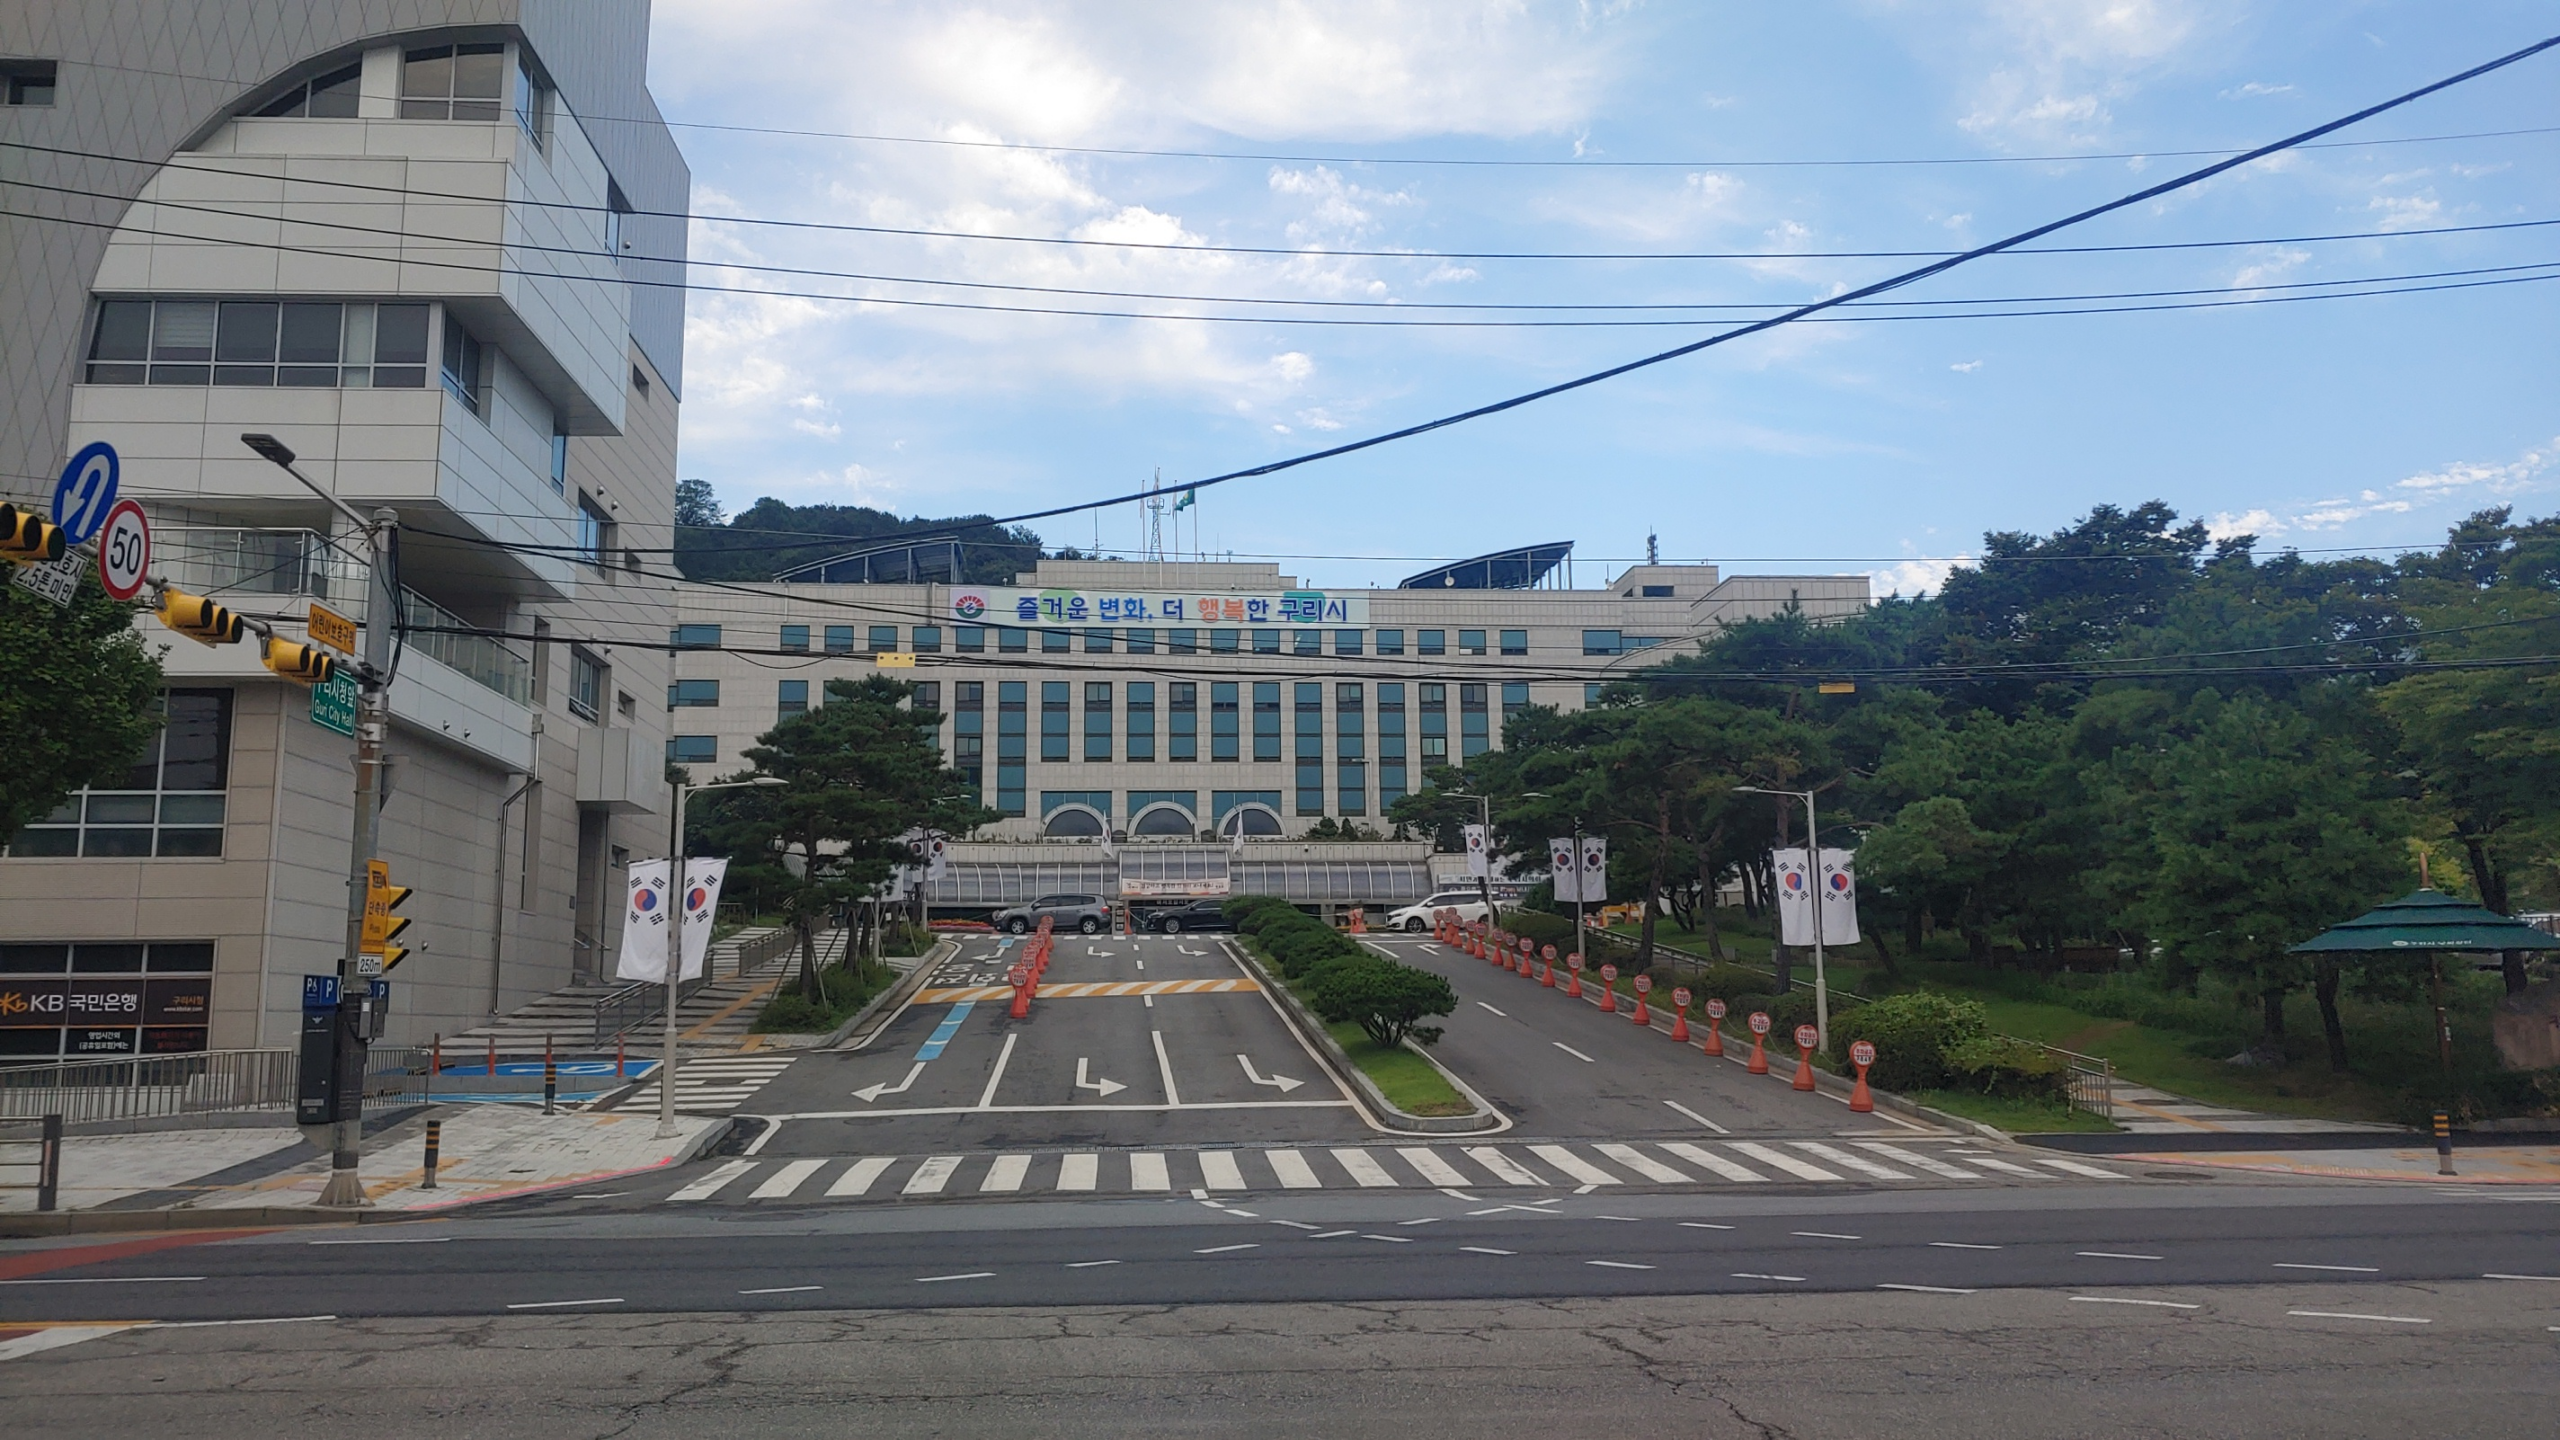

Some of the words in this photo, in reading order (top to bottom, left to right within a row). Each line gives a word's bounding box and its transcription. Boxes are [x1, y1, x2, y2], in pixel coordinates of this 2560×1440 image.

[110, 526, 142, 576] 50
[1017, 596, 1088, 620] 즐거운
[1099, 597, 1153, 622] 변화,
[1162, 598, 1184, 622] 더
[1198, 598, 1270, 623] 행복한
[1278, 598, 1347, 622] 구리시
[311, 612, 355, 648] 어린이보호구역
[314, 699, 328, 717] Guri
[328, 704, 341, 726] City
[341, 710, 353, 728] Hall
[360, 958, 381, 973] 250m
[326, 979, 334, 998] P
[30, 994, 64, 1012] KB
[69, 993, 138, 1012] 국민은행
